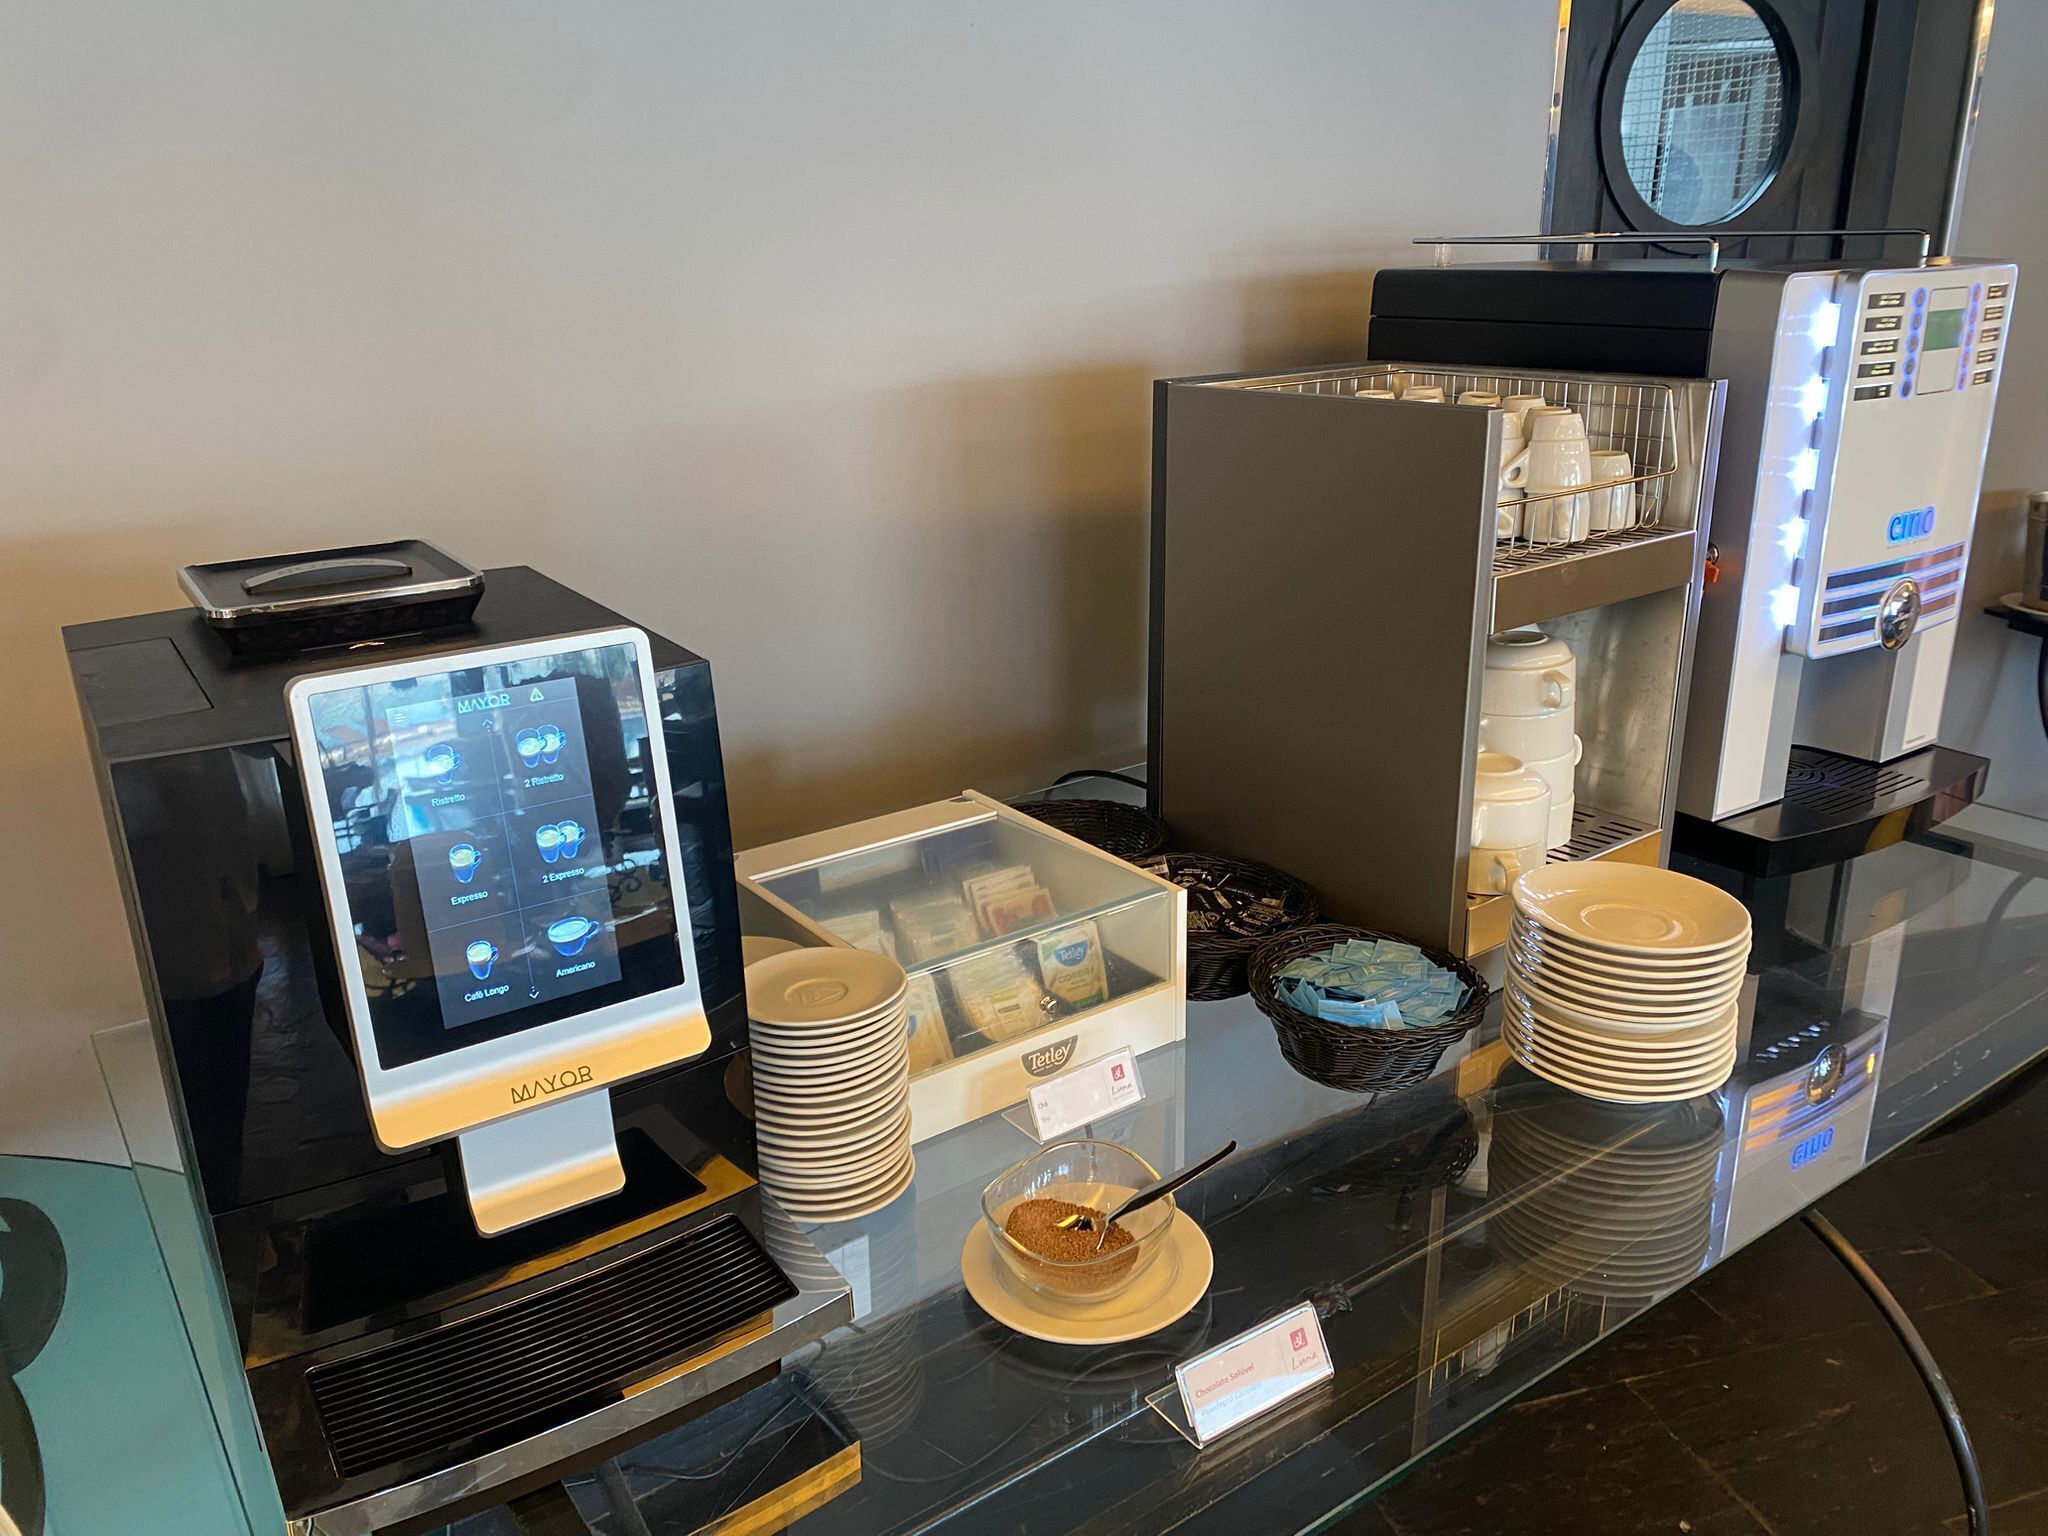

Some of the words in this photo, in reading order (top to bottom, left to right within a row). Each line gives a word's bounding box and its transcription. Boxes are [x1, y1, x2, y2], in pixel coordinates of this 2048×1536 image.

[457, 693, 511, 714] MAYOR
[524, 779, 531, 788] 2
[532, 773, 565, 786] Ristretto
[431, 793, 466, 807] Ristretto
[542, 875, 549, 884] 2
[550, 868, 585, 882] Expresso
[451, 891, 488, 905] Expresso
[1060, 946, 1085, 961] Tetley
[556, 961, 596, 977] Americano
[464, 990, 484, 1002] Café
[484, 984, 510, 998] Longo
[1028, 1042, 1072, 1070] Tetley
[511, 1065, 593, 1104] MAYOR
[1195, 1377, 1229, 1399] Chocolate
[1230, 1362, 1256, 1381] Solúvel
